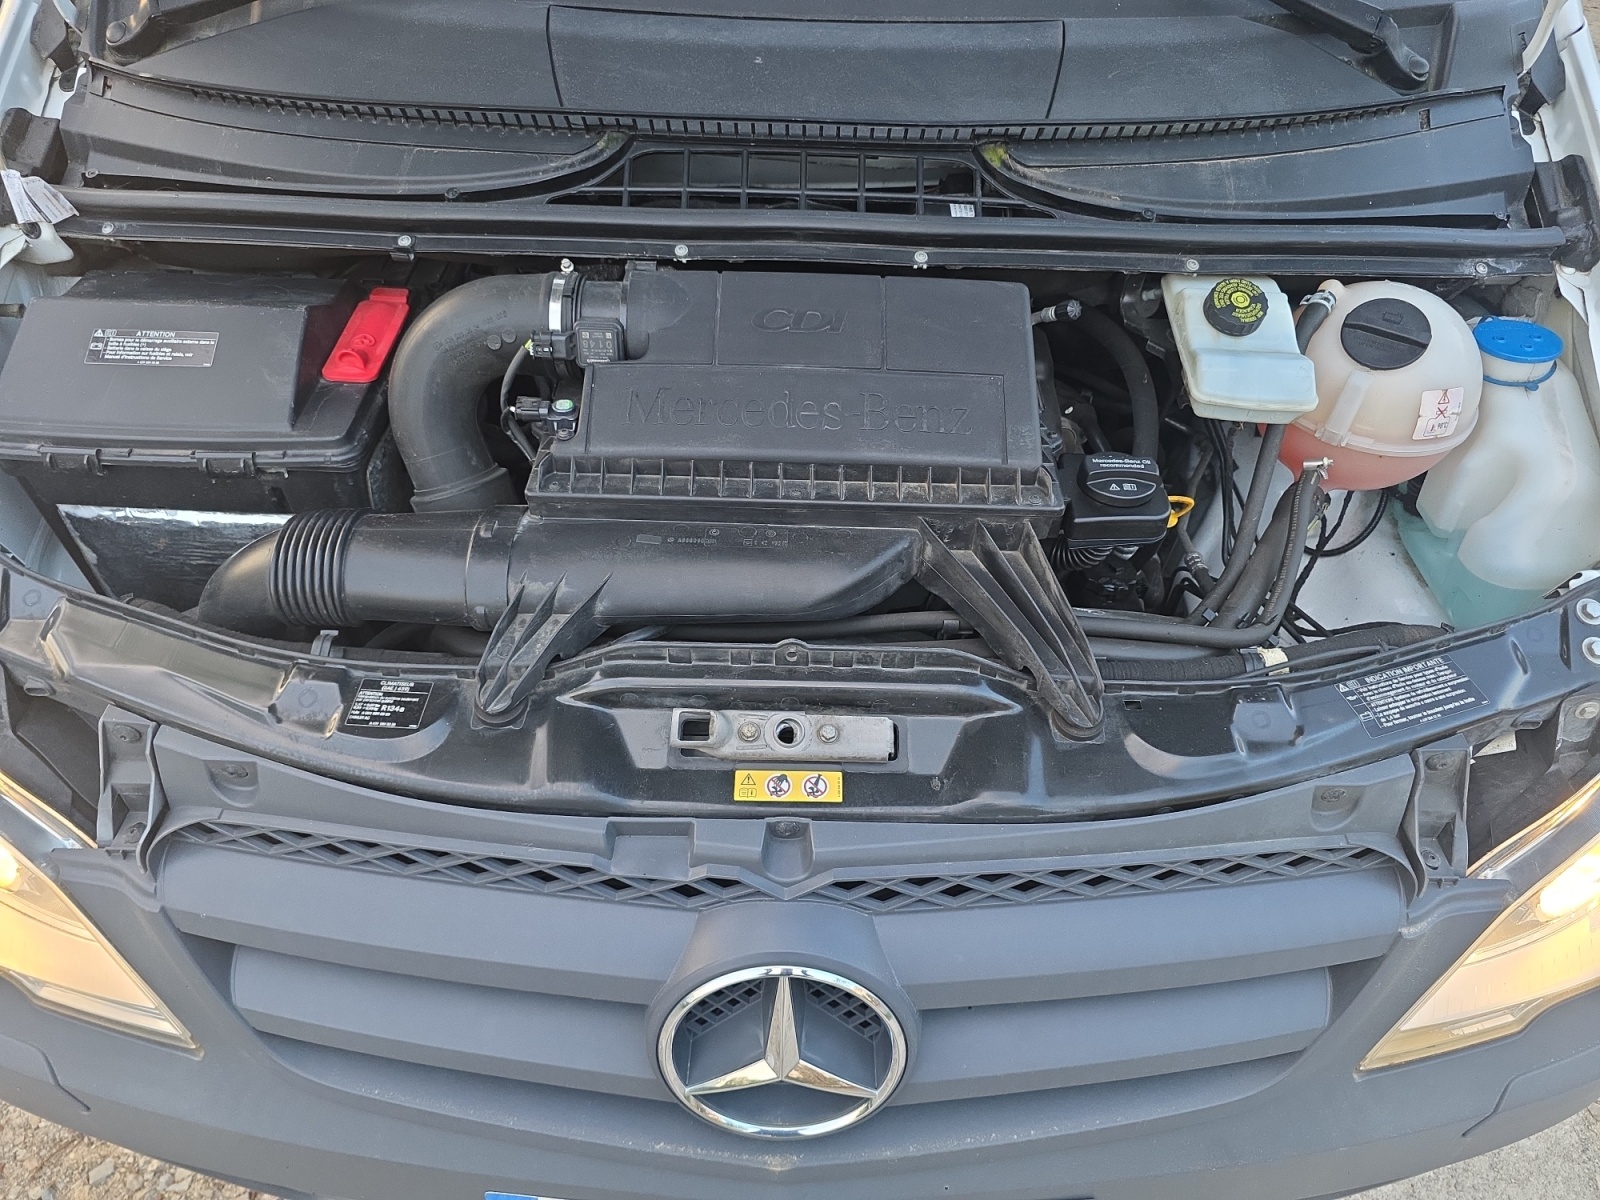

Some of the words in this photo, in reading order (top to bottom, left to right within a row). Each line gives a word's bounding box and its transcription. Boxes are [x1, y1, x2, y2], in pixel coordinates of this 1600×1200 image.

[751, 308, 850, 334] CDI
[623, 388, 973, 434] Mercedes-Benz
[1365, 669, 1403, 683] INDICATION
[1402, 658, 1443, 672] IMPORTANTE
